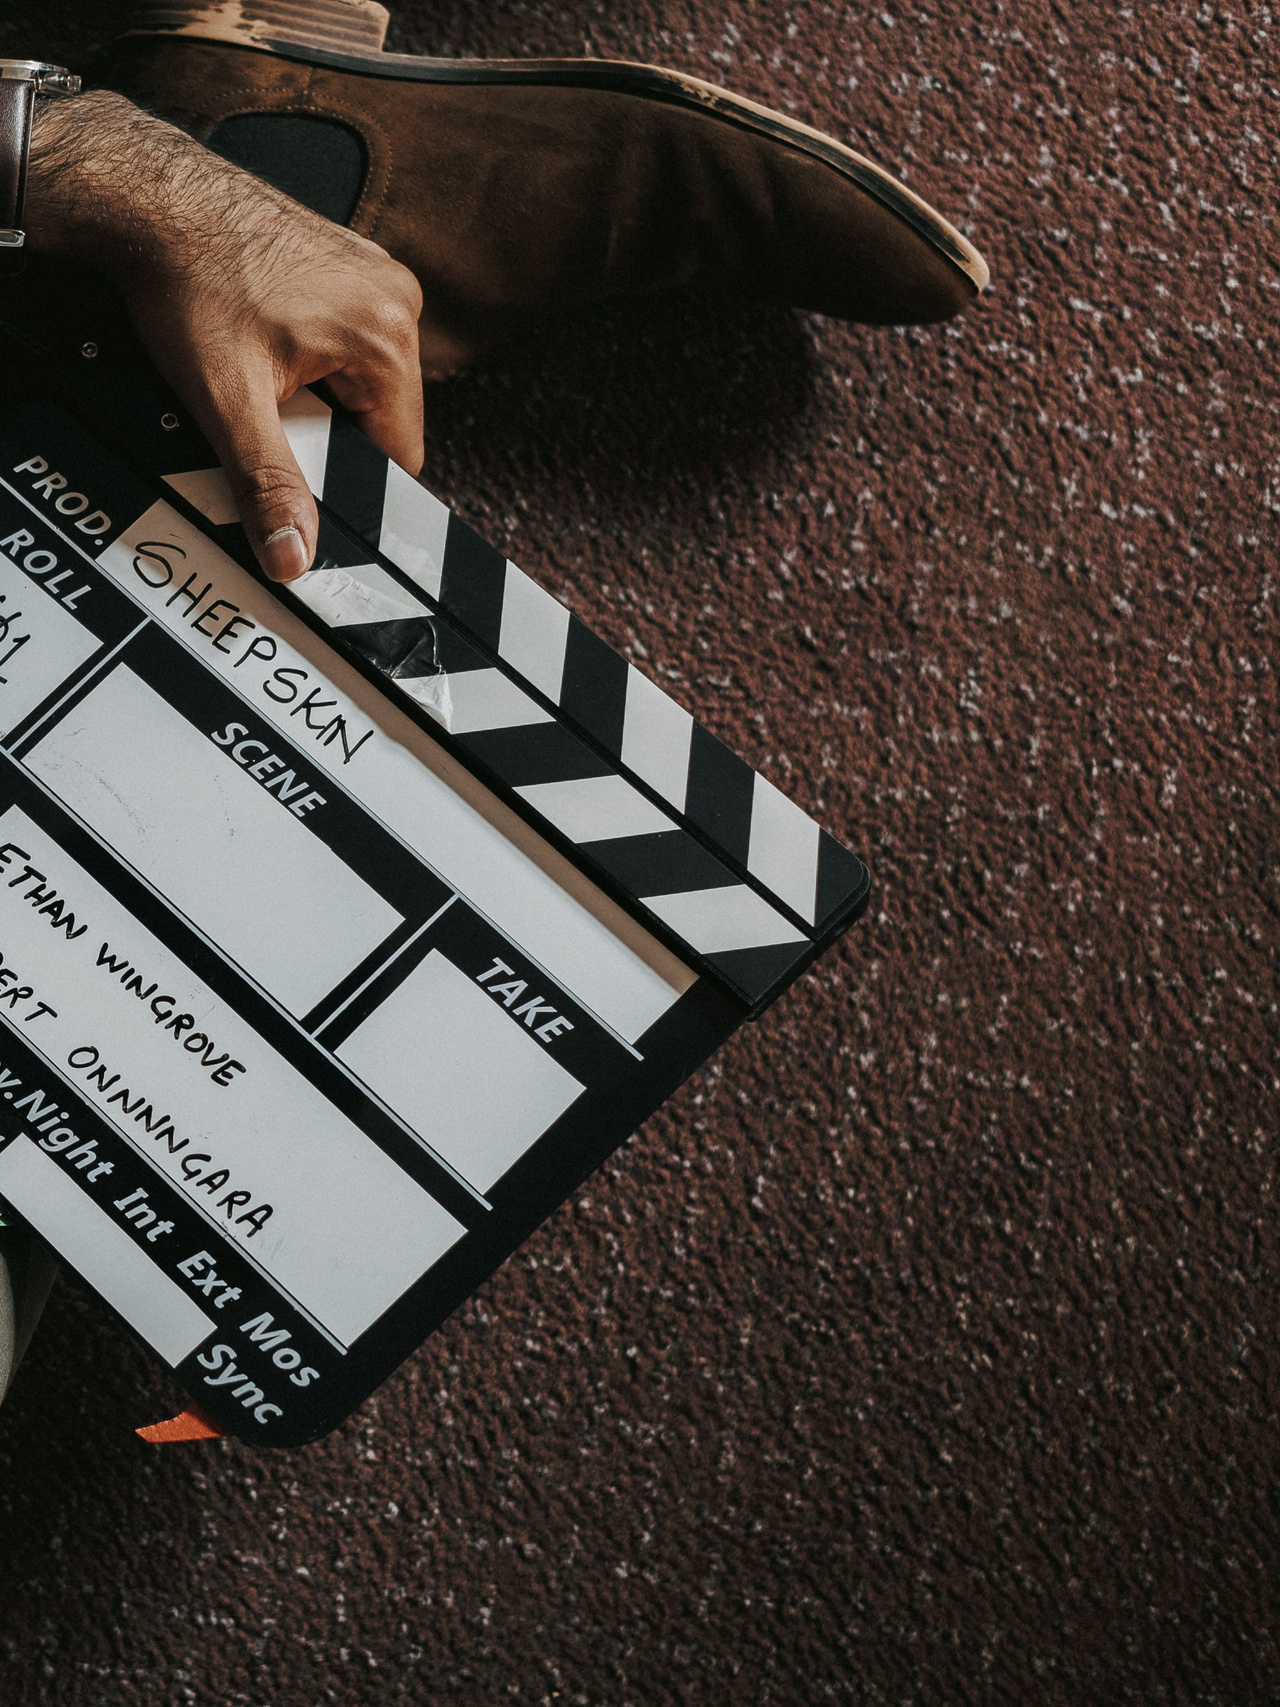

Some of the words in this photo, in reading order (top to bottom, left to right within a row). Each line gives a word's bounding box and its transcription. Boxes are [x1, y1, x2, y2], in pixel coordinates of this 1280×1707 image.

[13, 456, 112, 546] PROD.
[133, 541, 374, 764] SHEEPSKIN
[210, 722, 327, 817] SCENE
[96, 942, 247, 1088] WINGROVE
[475, 957, 575, 1044] TAKE
[112, 1187, 176, 1242] Int
[176, 1250, 243, 1309] Ext
[239, 1311, 321, 1387] Mos
[196, 1343, 284, 1425] Sync
